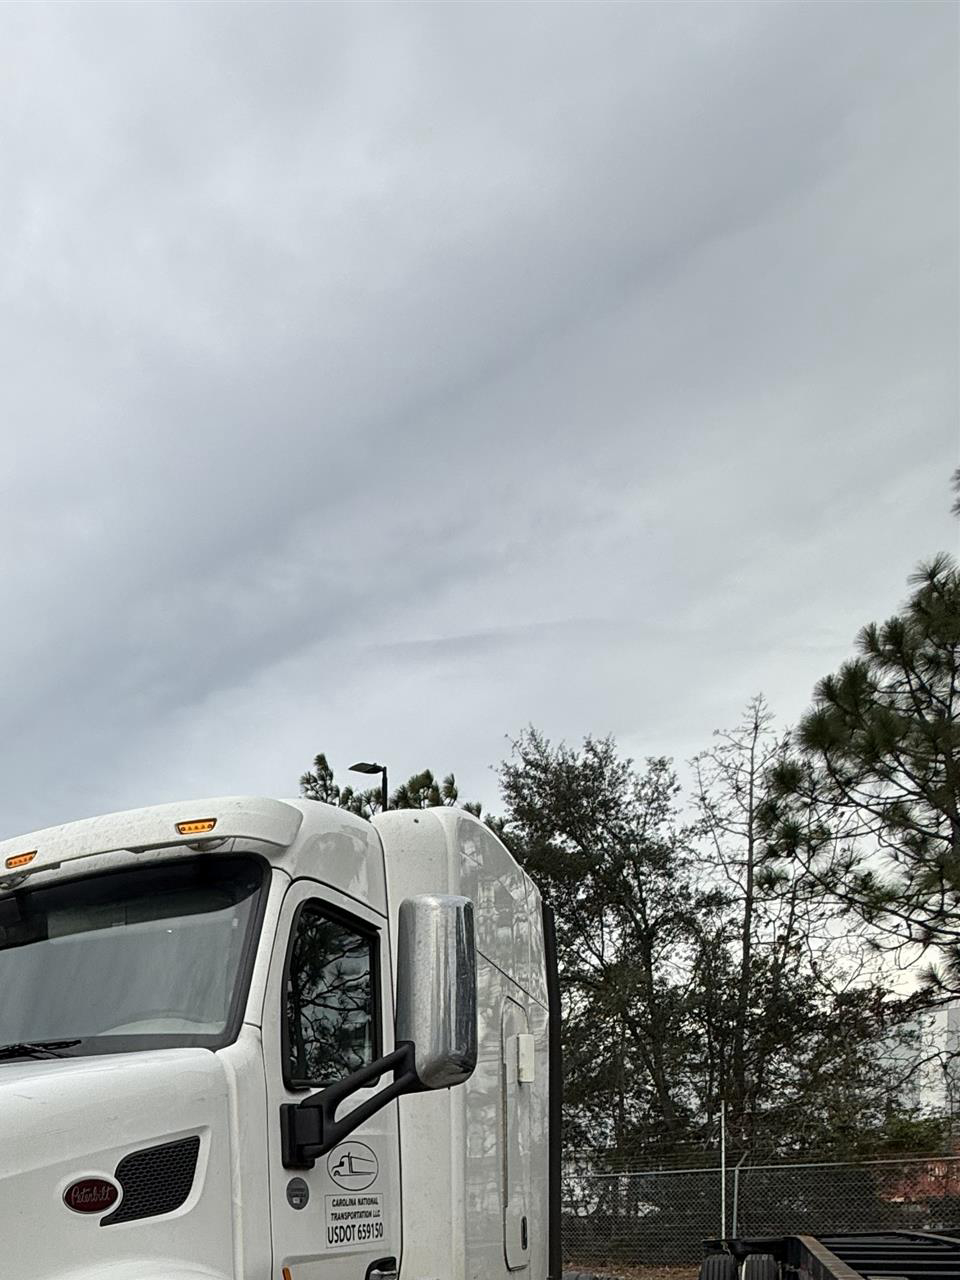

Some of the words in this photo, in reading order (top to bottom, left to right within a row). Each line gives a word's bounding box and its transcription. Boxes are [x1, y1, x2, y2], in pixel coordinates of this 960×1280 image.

[332, 1198, 356, 1207] CAROLINA
[357, 1197, 379, 1206] NATIONAL
[331, 1211, 372, 1221] TRANSPORTATION
[327, 1225, 356, 1244] USDOT
[357, 1222, 384, 1241] 659150
